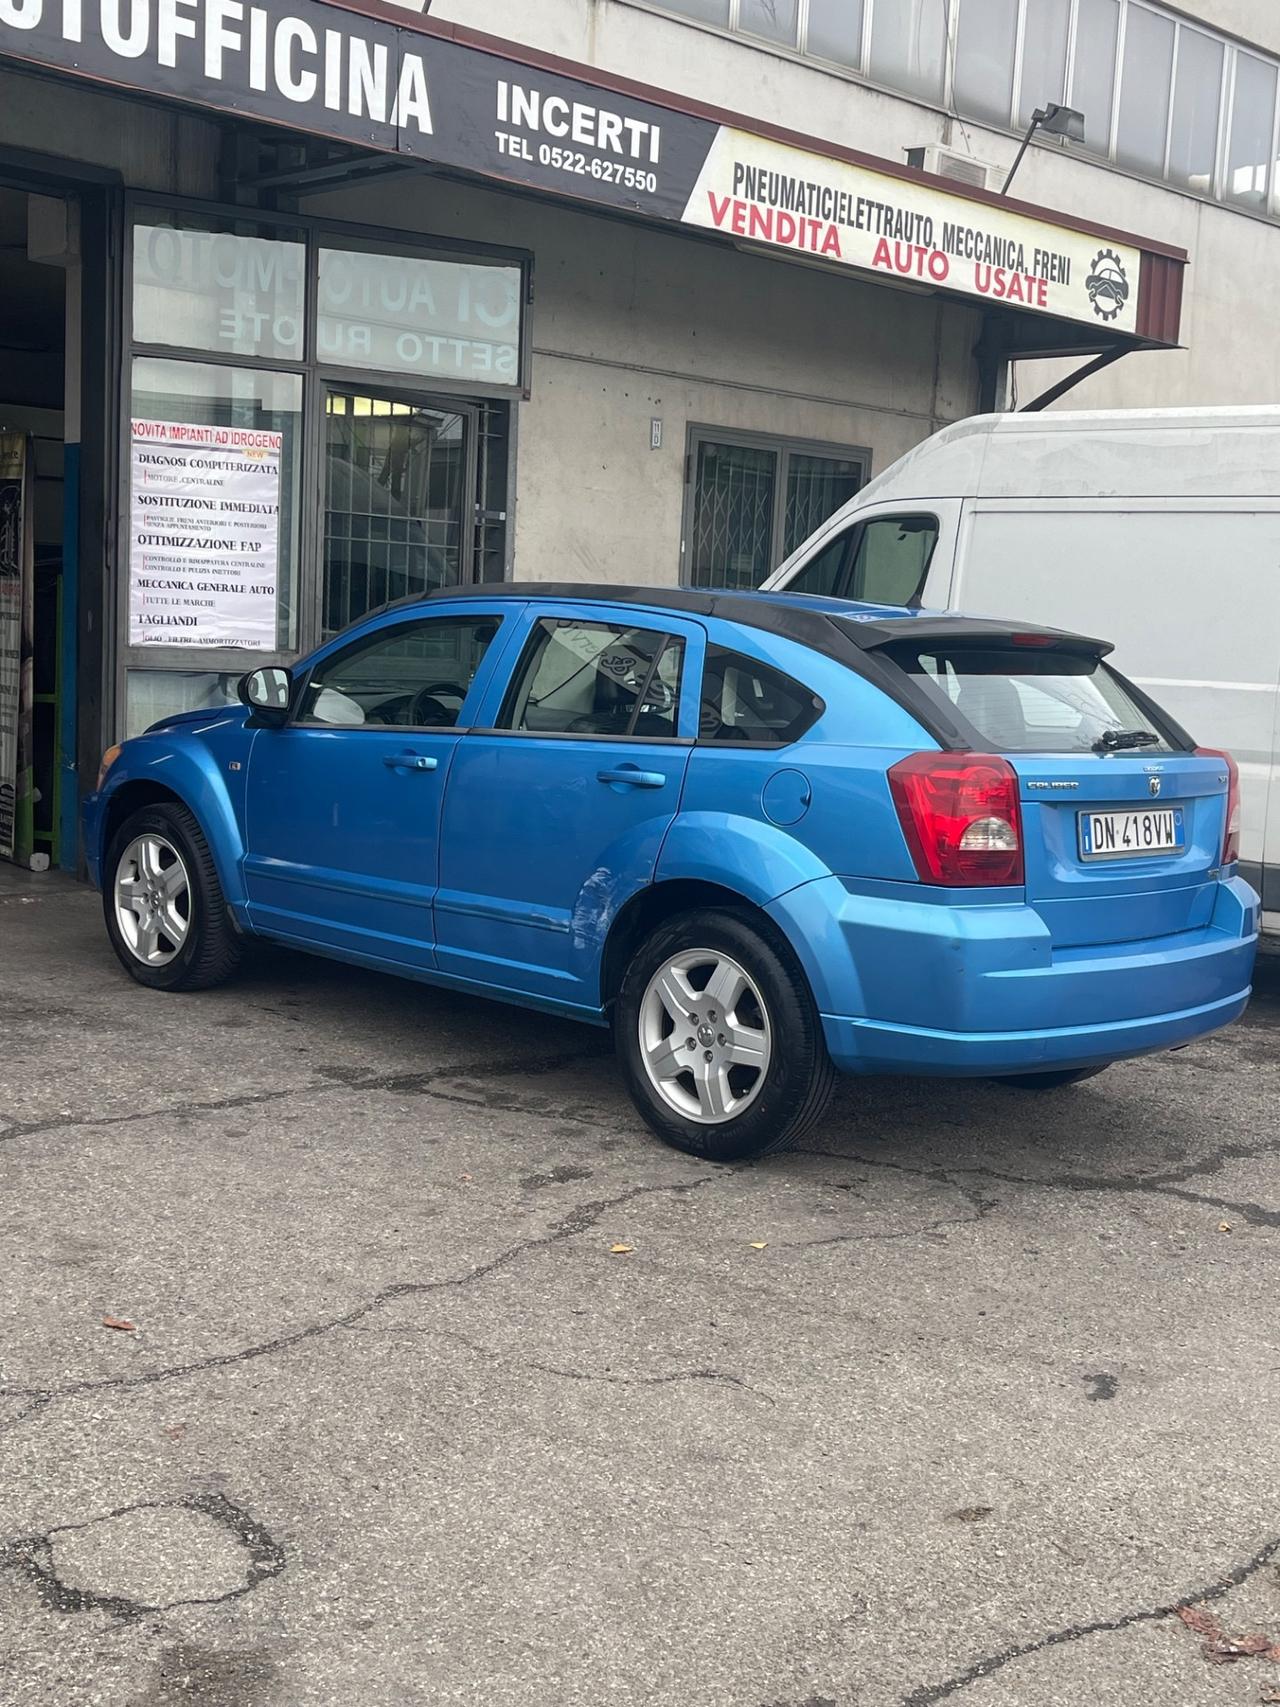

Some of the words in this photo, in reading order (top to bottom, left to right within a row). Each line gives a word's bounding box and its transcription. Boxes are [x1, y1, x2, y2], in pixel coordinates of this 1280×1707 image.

[497, 80, 661, 164] INCERTI
[495, 131, 534, 161] TEL
[539, 144, 657, 193] 0522-627550
[708, 191, 842, 258] VENDITA
[872, 237, 949, 281] AUTO
[975, 262, 1048, 307] USATE
[942, 222, 1029, 277] MECCANICA,
[1033, 248, 1071, 286] FRENI
[169, 426, 213, 443] IMPIANTI
[215, 431, 229, 444] AD
[231, 432, 282, 449] IDROGENO
[138, 453, 187, 468] DIAGNOSI
[190, 459, 278, 475] COMPUTERIZZATA
[147, 474, 178, 483] MOTORE
[137, 495, 217, 510] SOSTITUZIONE
[220, 501, 279, 515] IMMEDIATA
[137, 534, 238, 551] OTTIMIZZAZIONE
[240, 541, 262, 552] FAP
[145, 555, 181, 563] CONTROLLO
[145, 564, 181, 572] CONTROLLO
[188, 567, 211, 575] PULIZIA
[137, 579, 194, 591] MECCANICA
[197, 582, 247, 593] GENERALE
[249, 586, 275, 595] AUTO
[145, 596, 169, 605] TUTTE
[183, 599, 216, 607] MARCHE
[137, 614, 198, 627] TAGLIANDI
[1093, 816, 1115, 850] DN
[1122, 812, 1174, 848] 418VW
